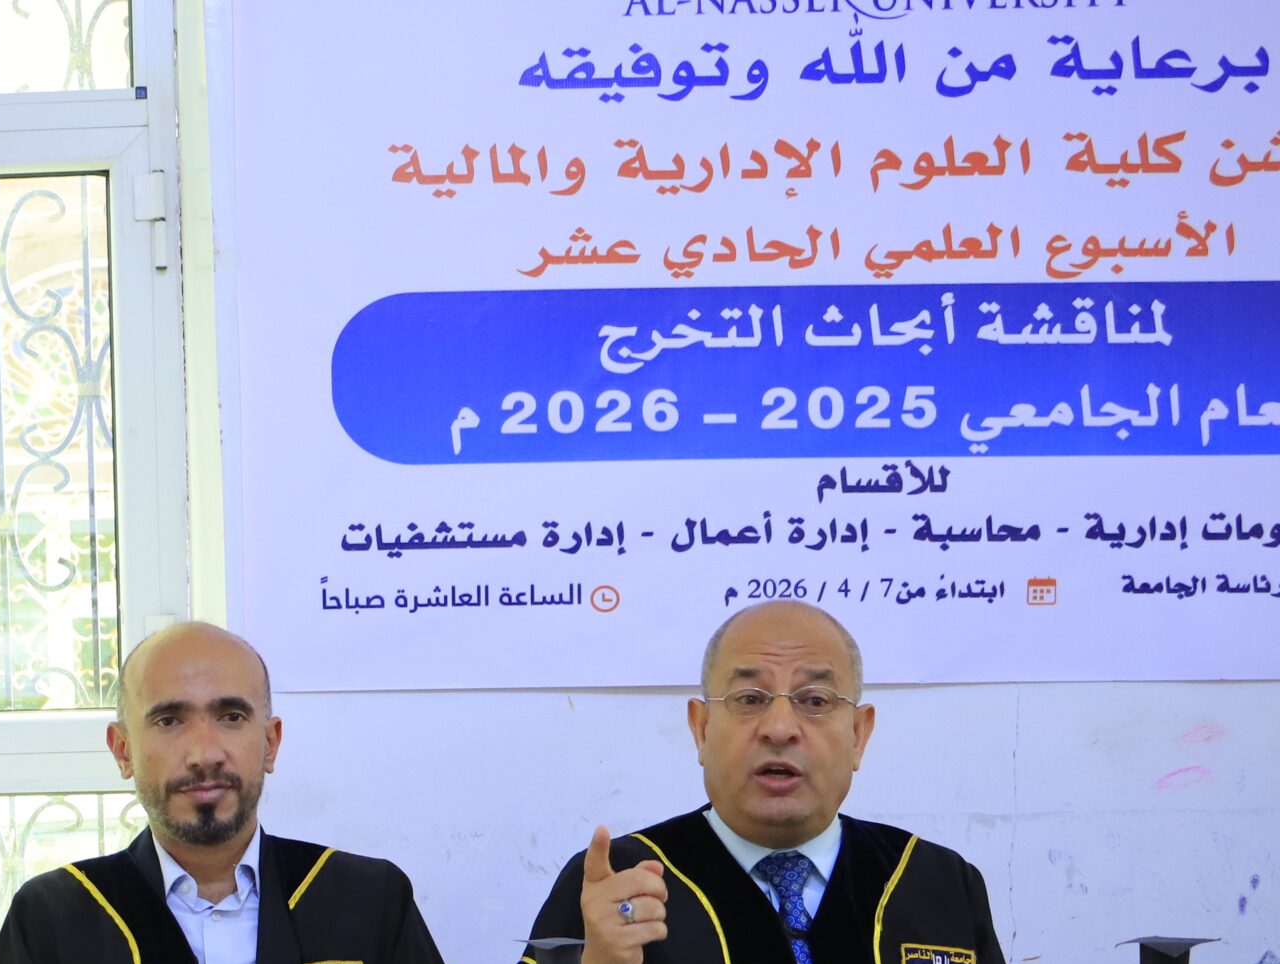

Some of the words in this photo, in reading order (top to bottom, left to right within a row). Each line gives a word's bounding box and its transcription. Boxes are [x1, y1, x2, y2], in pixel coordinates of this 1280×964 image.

[519, 43, 769, 102] وتوفيقه
[936, 47, 1016, 97] من
[1047, 35, 1269, 95] برعاية
[389, 144, 585, 198] والمالية
[614, 138, 841, 197] الإدارية
[870, 135, 1030, 192] العلوم
[1063, 131, 1186, 188] كلية
[518, 227, 640, 277] عشر
[664, 225, 839, 278] الحادي
[865, 223, 1020, 278] العلمي
[1046, 211, 1235, 279] الأسبوع
[599, 304, 783, 373] التخرج
[805, 293, 955, 355] أبحاث
[977, 298, 1172, 345] لمناقشة
[451, 407, 480, 455] م
[501, 389, 679, 433] 2026
[761, 386, 936, 429] 2025
[961, 383, 1179, 453] الجامعي
[817, 460, 950, 503] للأقسام
[341, 521, 527, 558] مستشفيات
[542, 521, 626, 555] إدارة
[671, 511, 772, 552] أعمال
[788, 517, 869, 552] إدارة
[912, 514, 1040, 551] محاسبة
[1084, 513, 1188, 550] إدارية
[395, 585, 489, 613] العاشرة
[499, 584, 581, 605] الساعة
[748, 579, 807, 598] 2026
[1122, 575, 1206, 599] الجامعة
